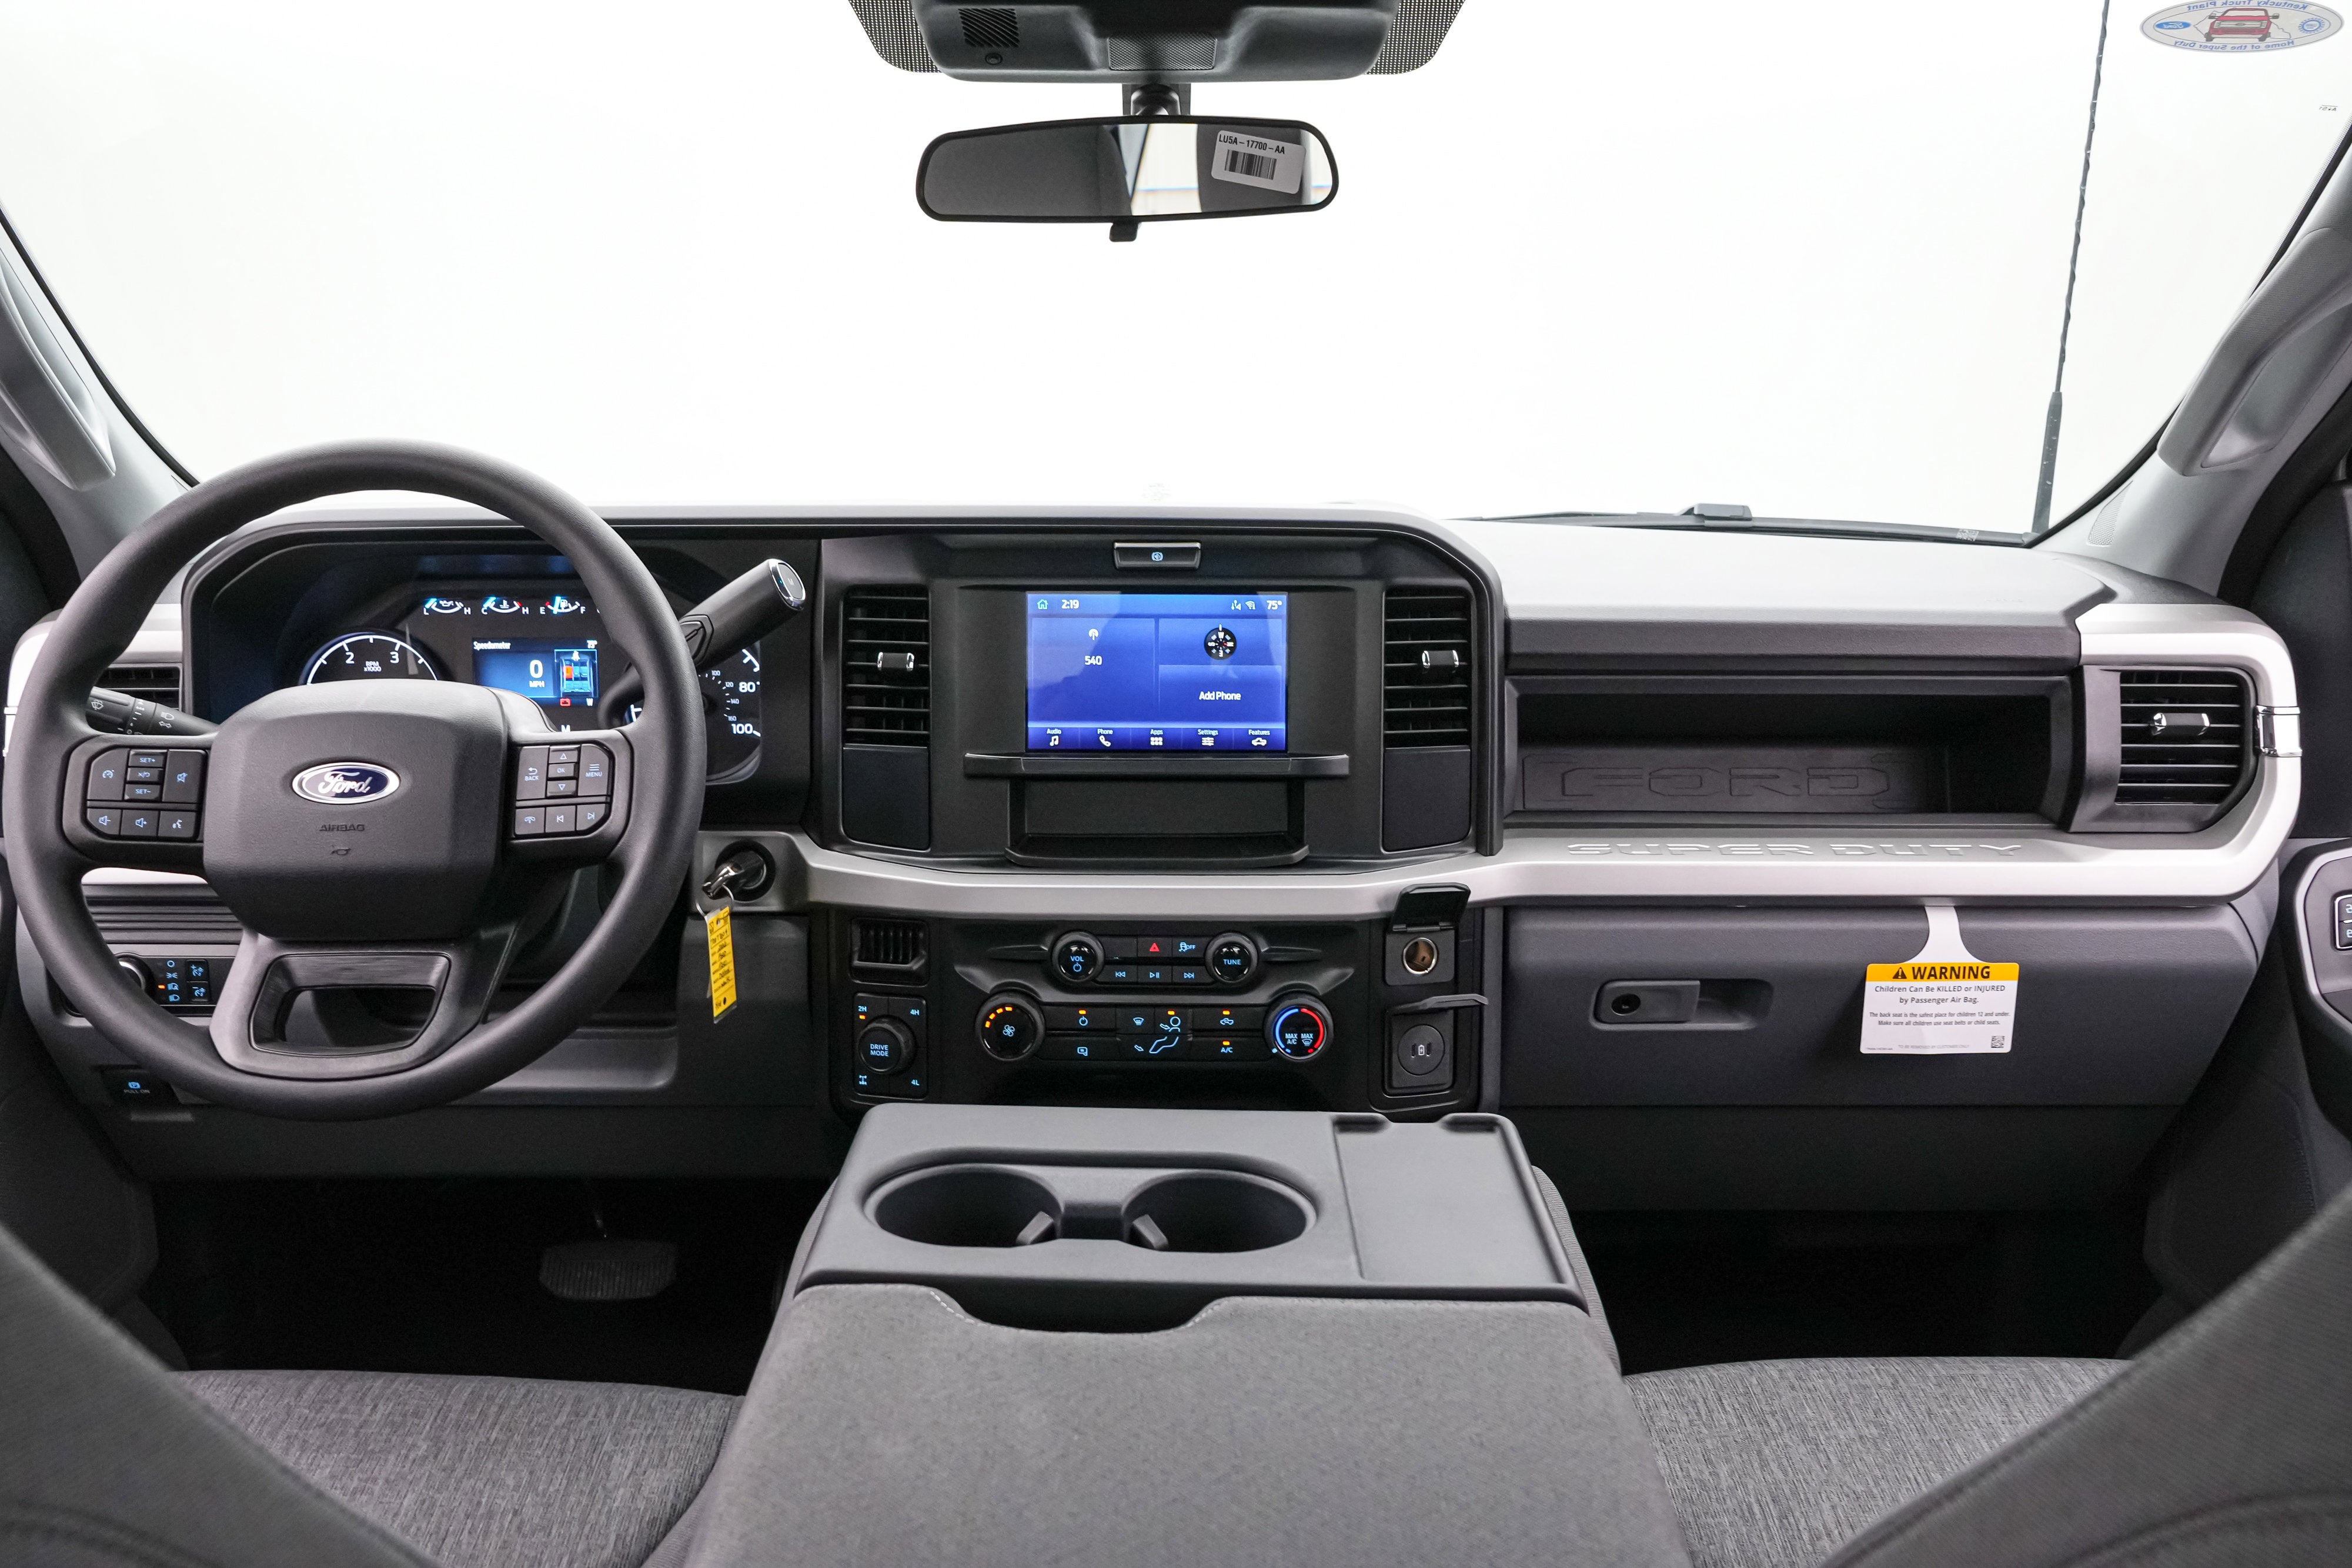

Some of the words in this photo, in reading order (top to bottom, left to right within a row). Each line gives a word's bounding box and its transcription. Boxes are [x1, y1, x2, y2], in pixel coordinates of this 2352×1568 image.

[540, 606, 546, 614] E
[1061, 600, 1080, 609] 2:19
[1267, 600, 1282, 610] 75°
[463, 607, 471, 615] H
[473, 641, 511, 651] Speedometer
[345, 651, 355, 664] 2
[390, 651, 399, 664] 3
[1085, 656, 1102, 666] 540
[529, 659, 543, 678] 0
[739, 681, 756, 693] 80
[1199, 691, 1215, 700] Add
[1215, 691, 1241, 700] Phone
[731, 723, 753, 734] 100
[318, 771, 373, 795] Ford
[1562, 767, 1890, 797] FORD
[1567, 843, 1815, 855] SUPER
[1829, 844, 2022, 856] DUTY
[1912, 966, 1990, 980] WARNING
[1974, 985, 2006, 993] INJURED
